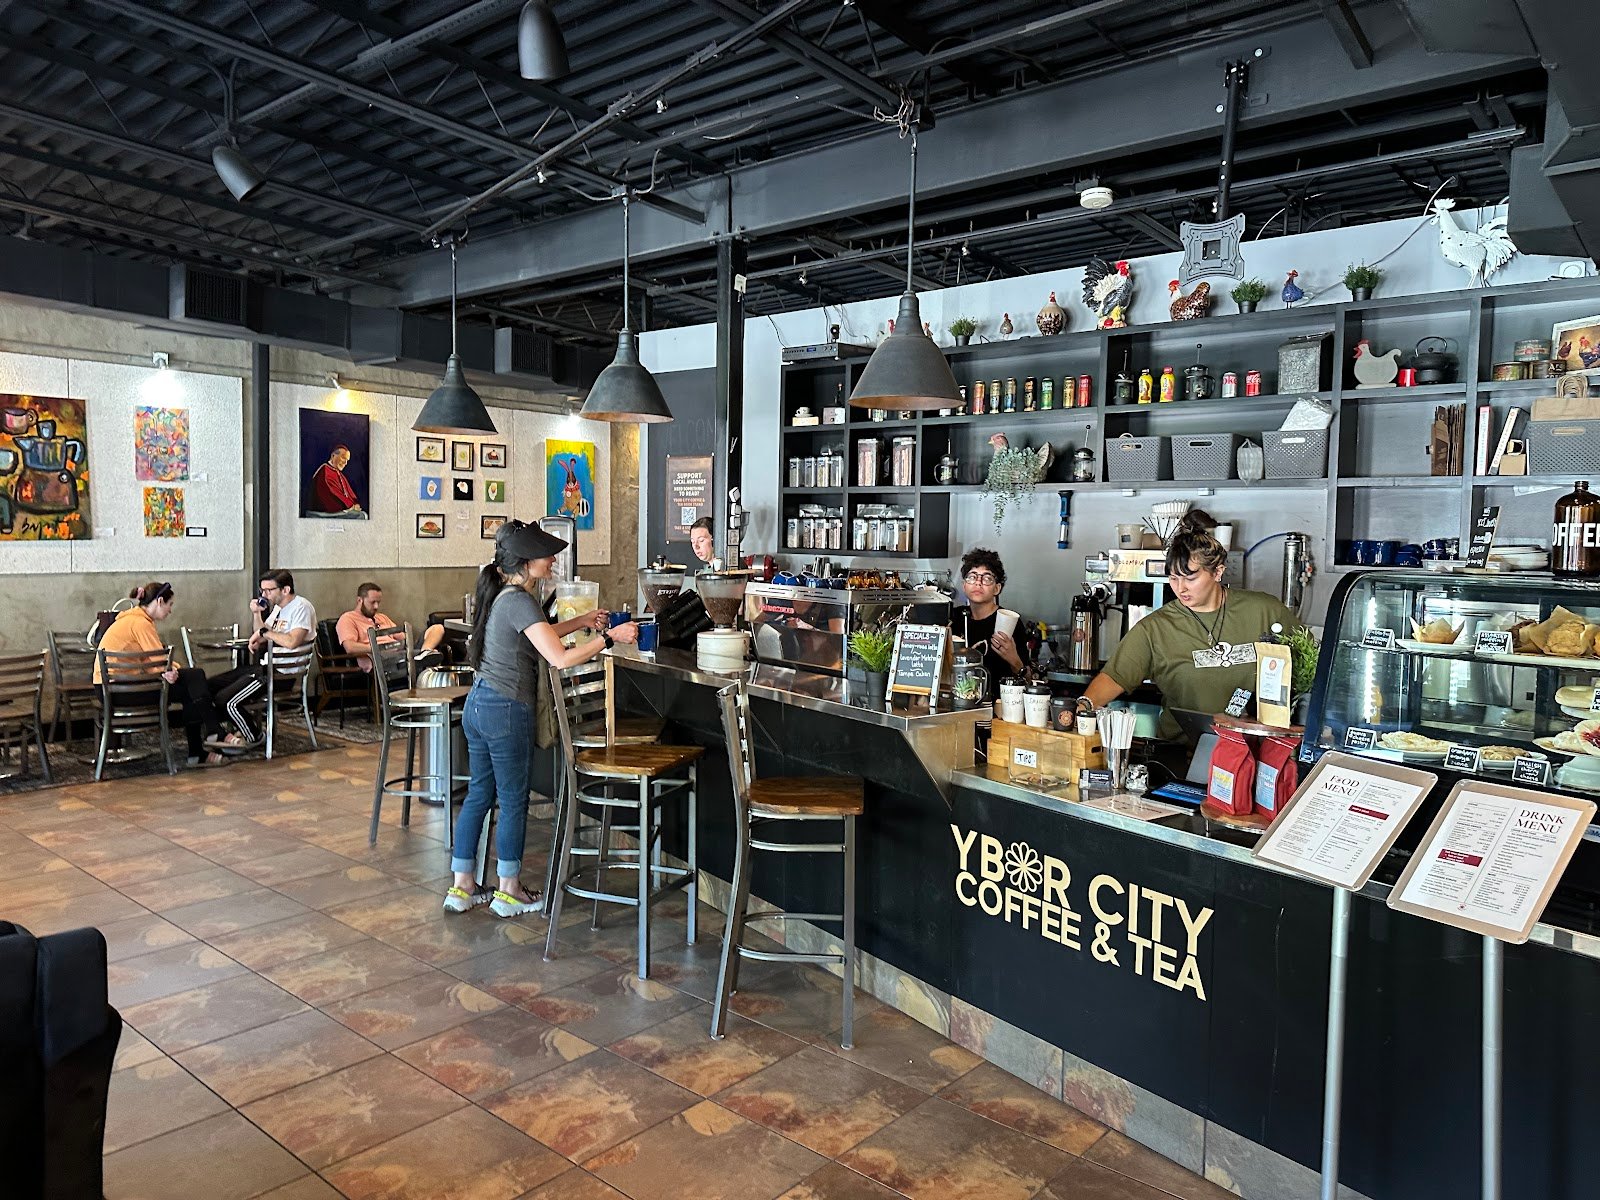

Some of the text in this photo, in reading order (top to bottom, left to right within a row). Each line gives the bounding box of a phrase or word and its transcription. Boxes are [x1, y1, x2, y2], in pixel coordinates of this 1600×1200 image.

[1518, 761, 1542, 769] DANISH
[1322, 783, 1357, 797] MENU
[1520, 809, 1566, 824] DRINK
[1515, 819, 1562, 834] MENU
[1088, 874, 1214, 956] CITY
[955, 871, 1206, 1001] COFFEE & TEA
